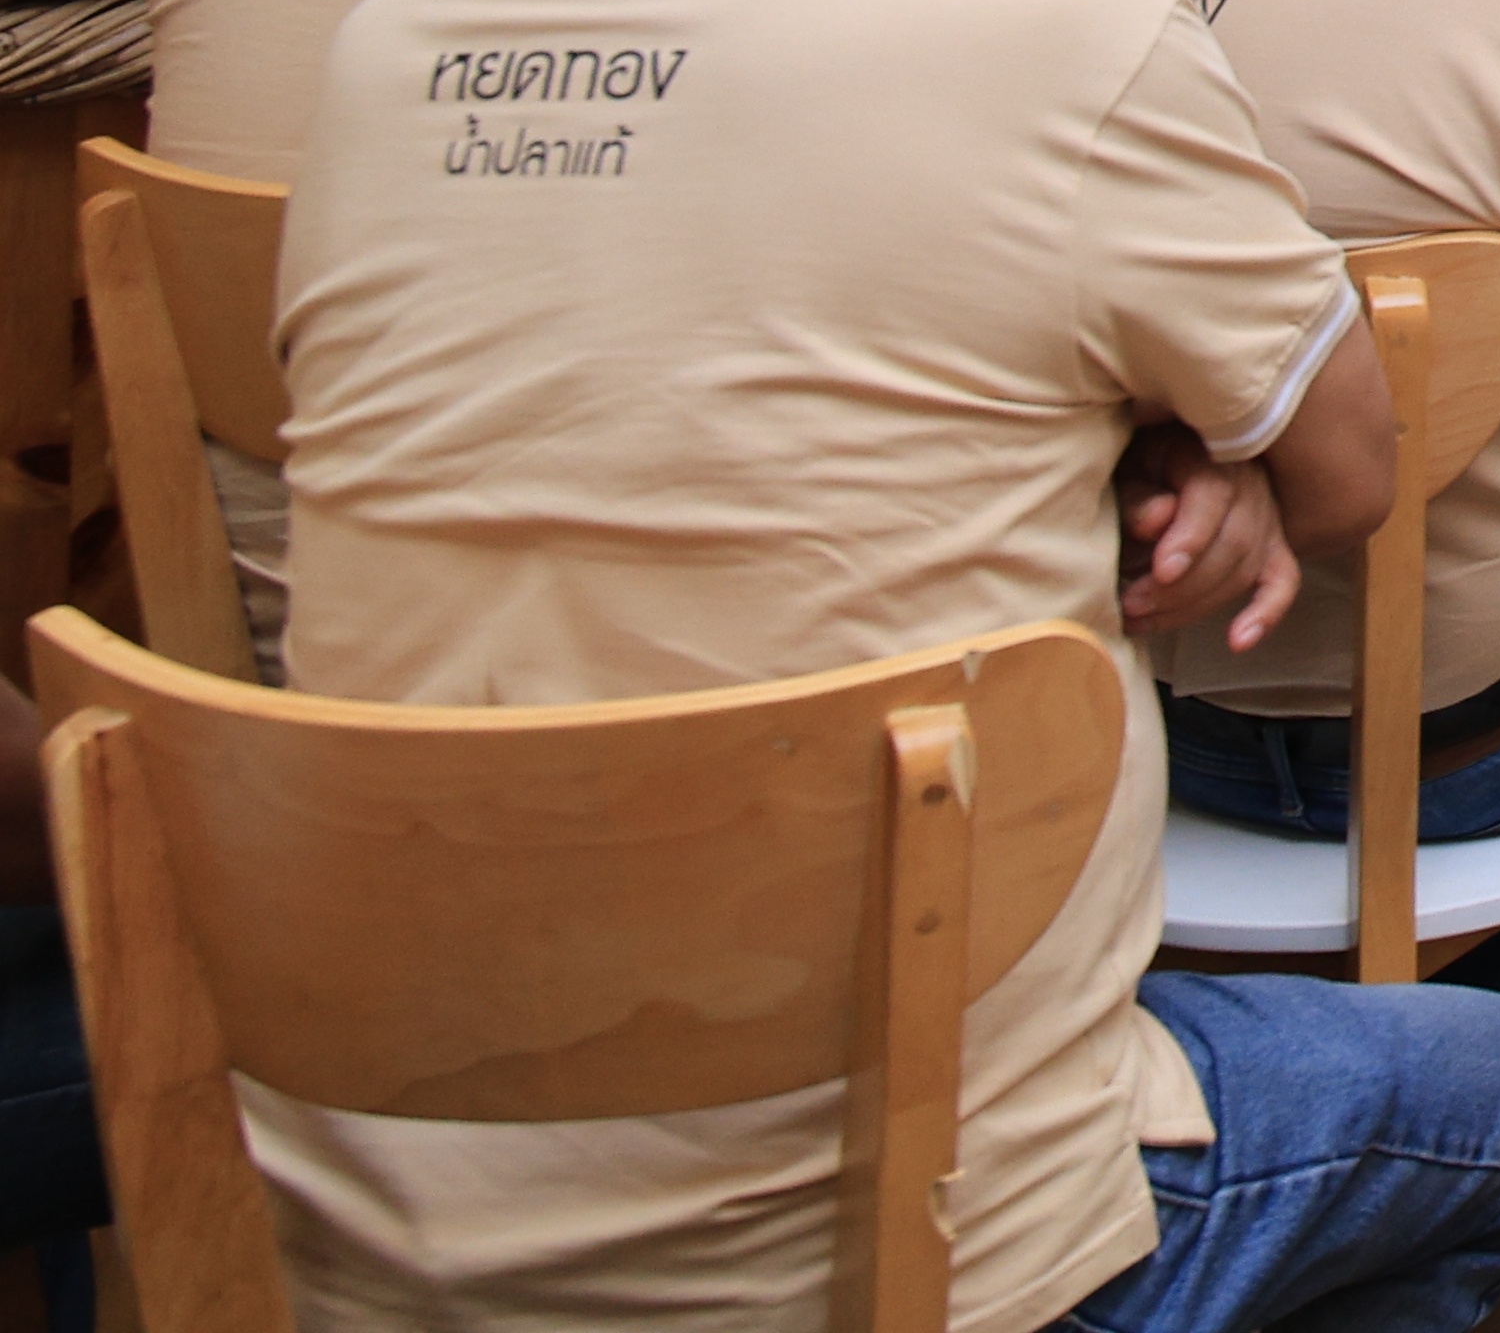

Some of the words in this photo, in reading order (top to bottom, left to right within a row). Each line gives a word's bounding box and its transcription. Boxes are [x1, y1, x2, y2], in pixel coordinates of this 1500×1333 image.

[427, 46, 687, 105] หยดทอง
[444, 116, 634, 178] น้ำปลาแท้
